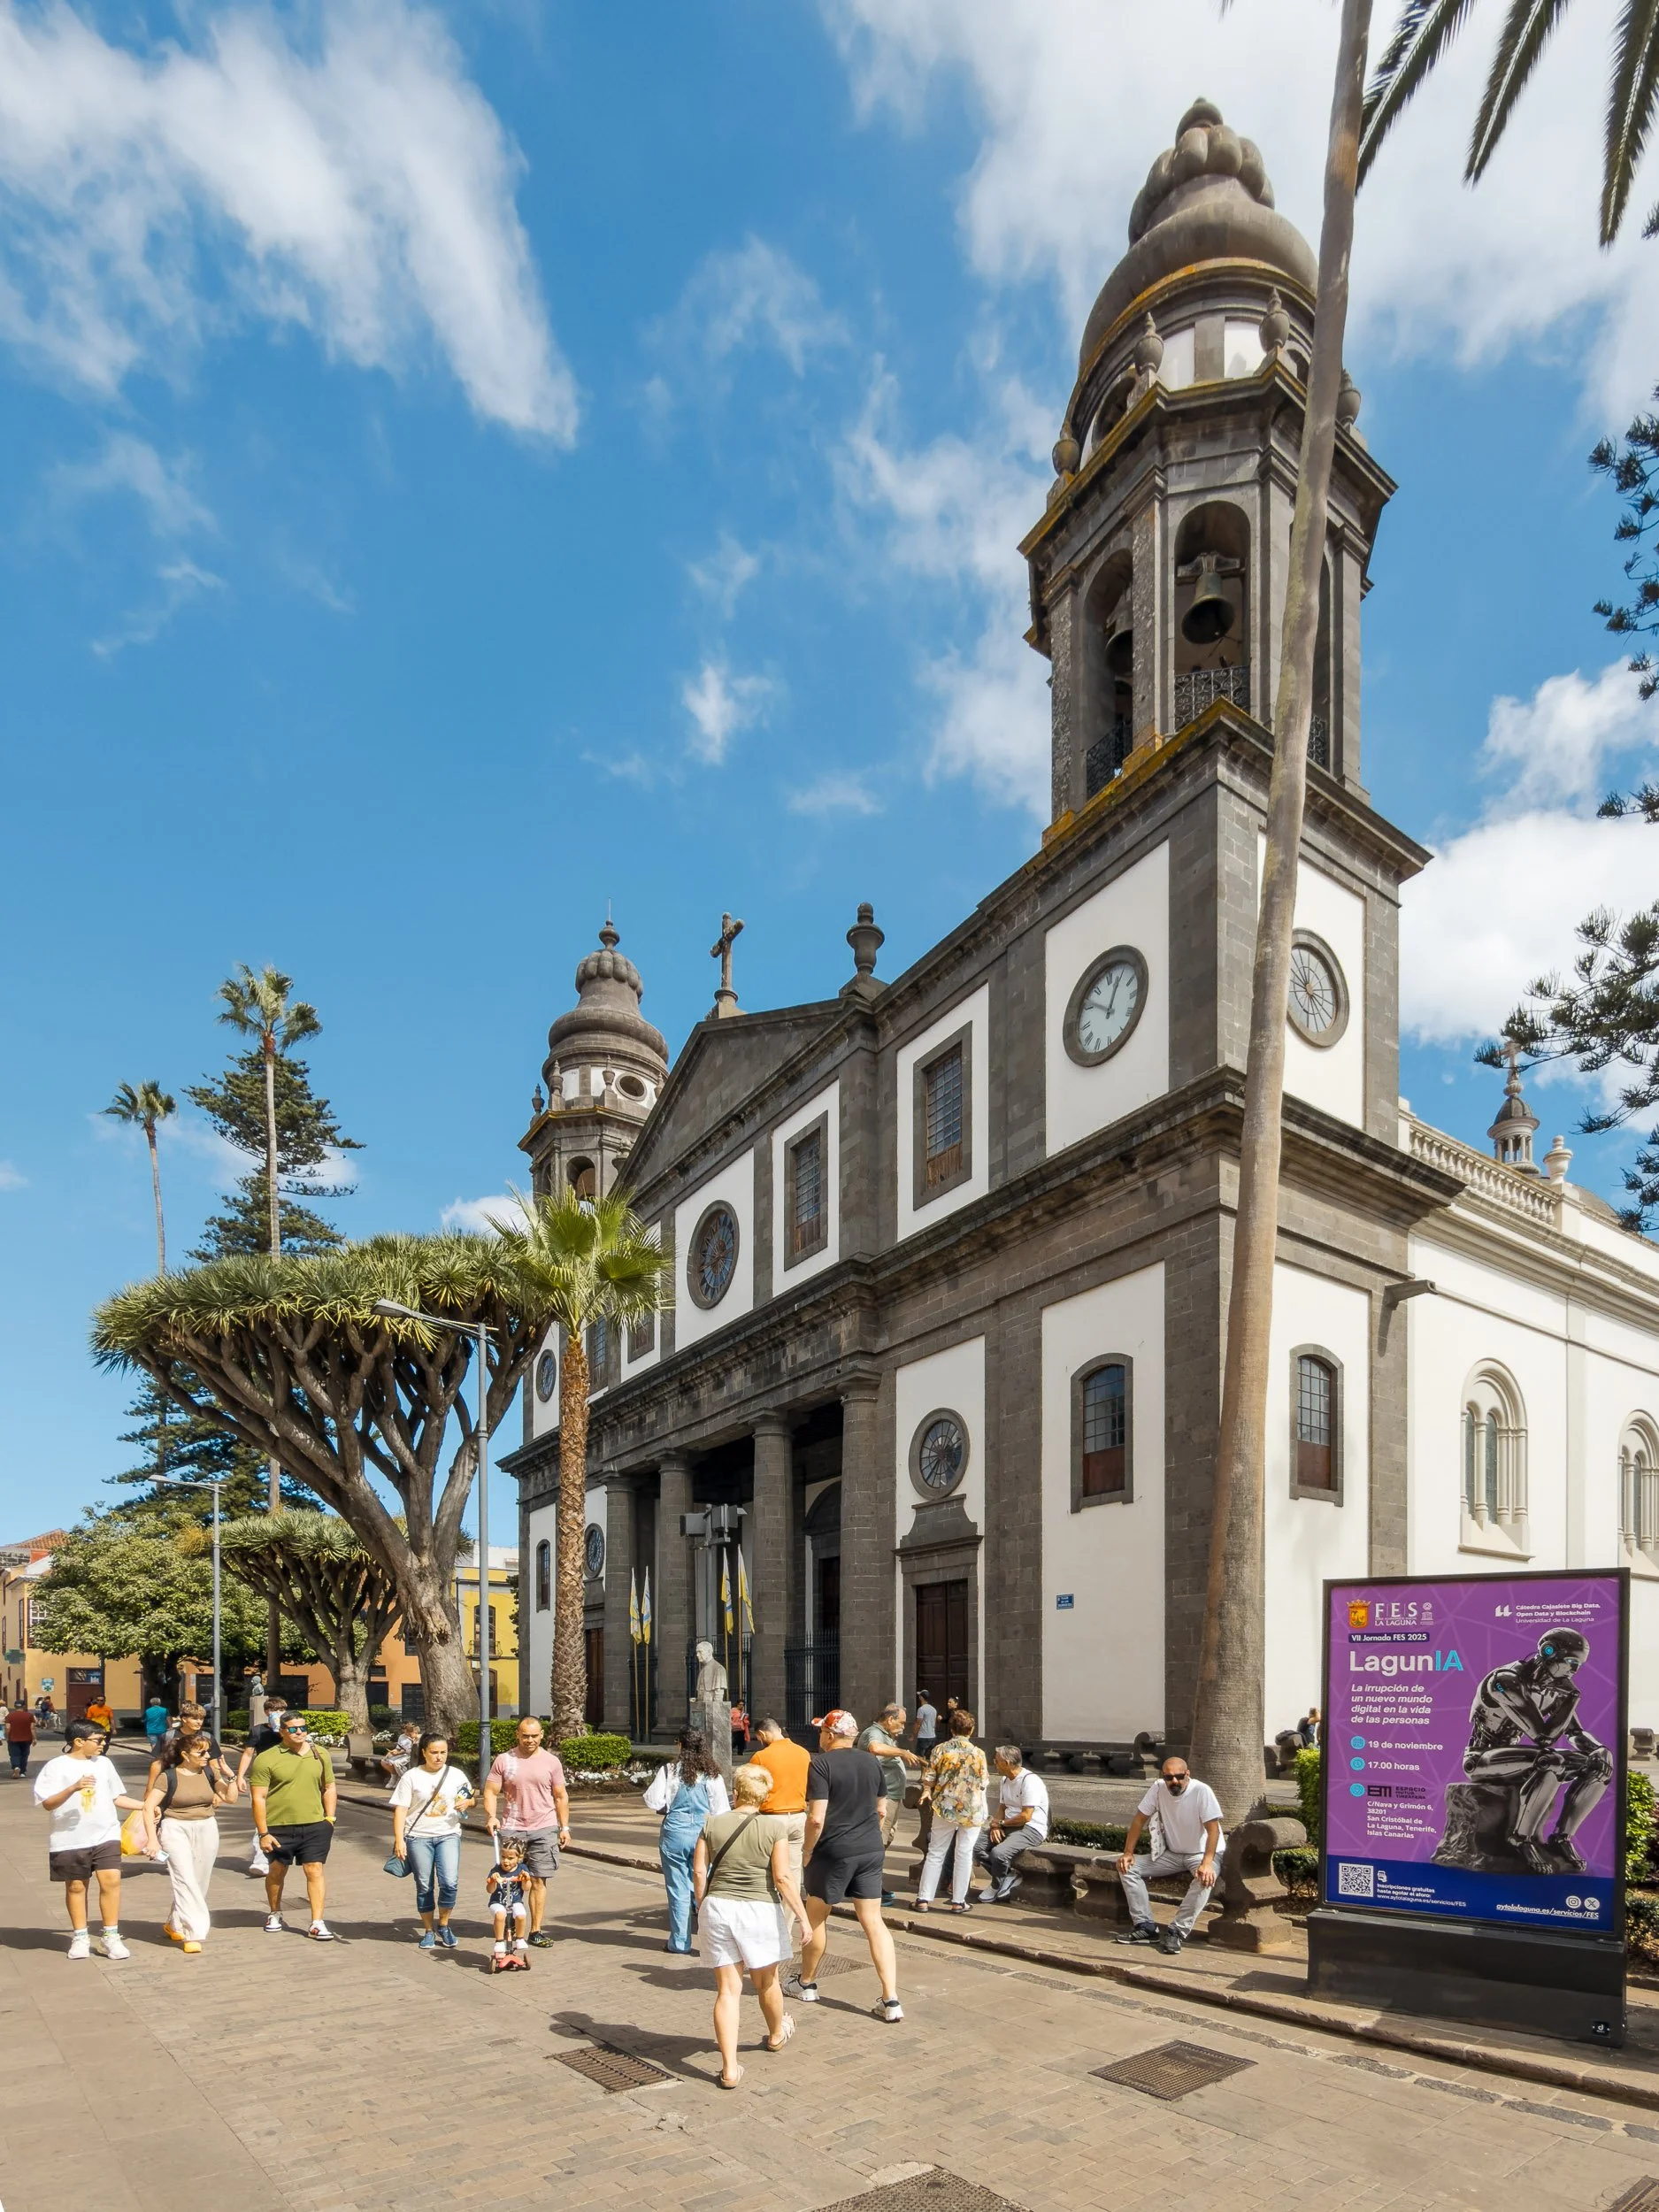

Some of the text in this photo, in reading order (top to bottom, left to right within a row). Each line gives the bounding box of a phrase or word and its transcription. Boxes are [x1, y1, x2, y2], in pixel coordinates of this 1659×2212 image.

[1349, 1649, 1463, 1676] LagunIA
[1364, 1684, 1409, 1694] irrupción
[1351, 1704, 1381, 1714] digital
[1366, 1715, 1380, 1724] las
[1394, 1741, 1443, 1750] noviembre
[1378, 1894, 1466, 1906] www.aytolalaguna.es/servicios/FES
